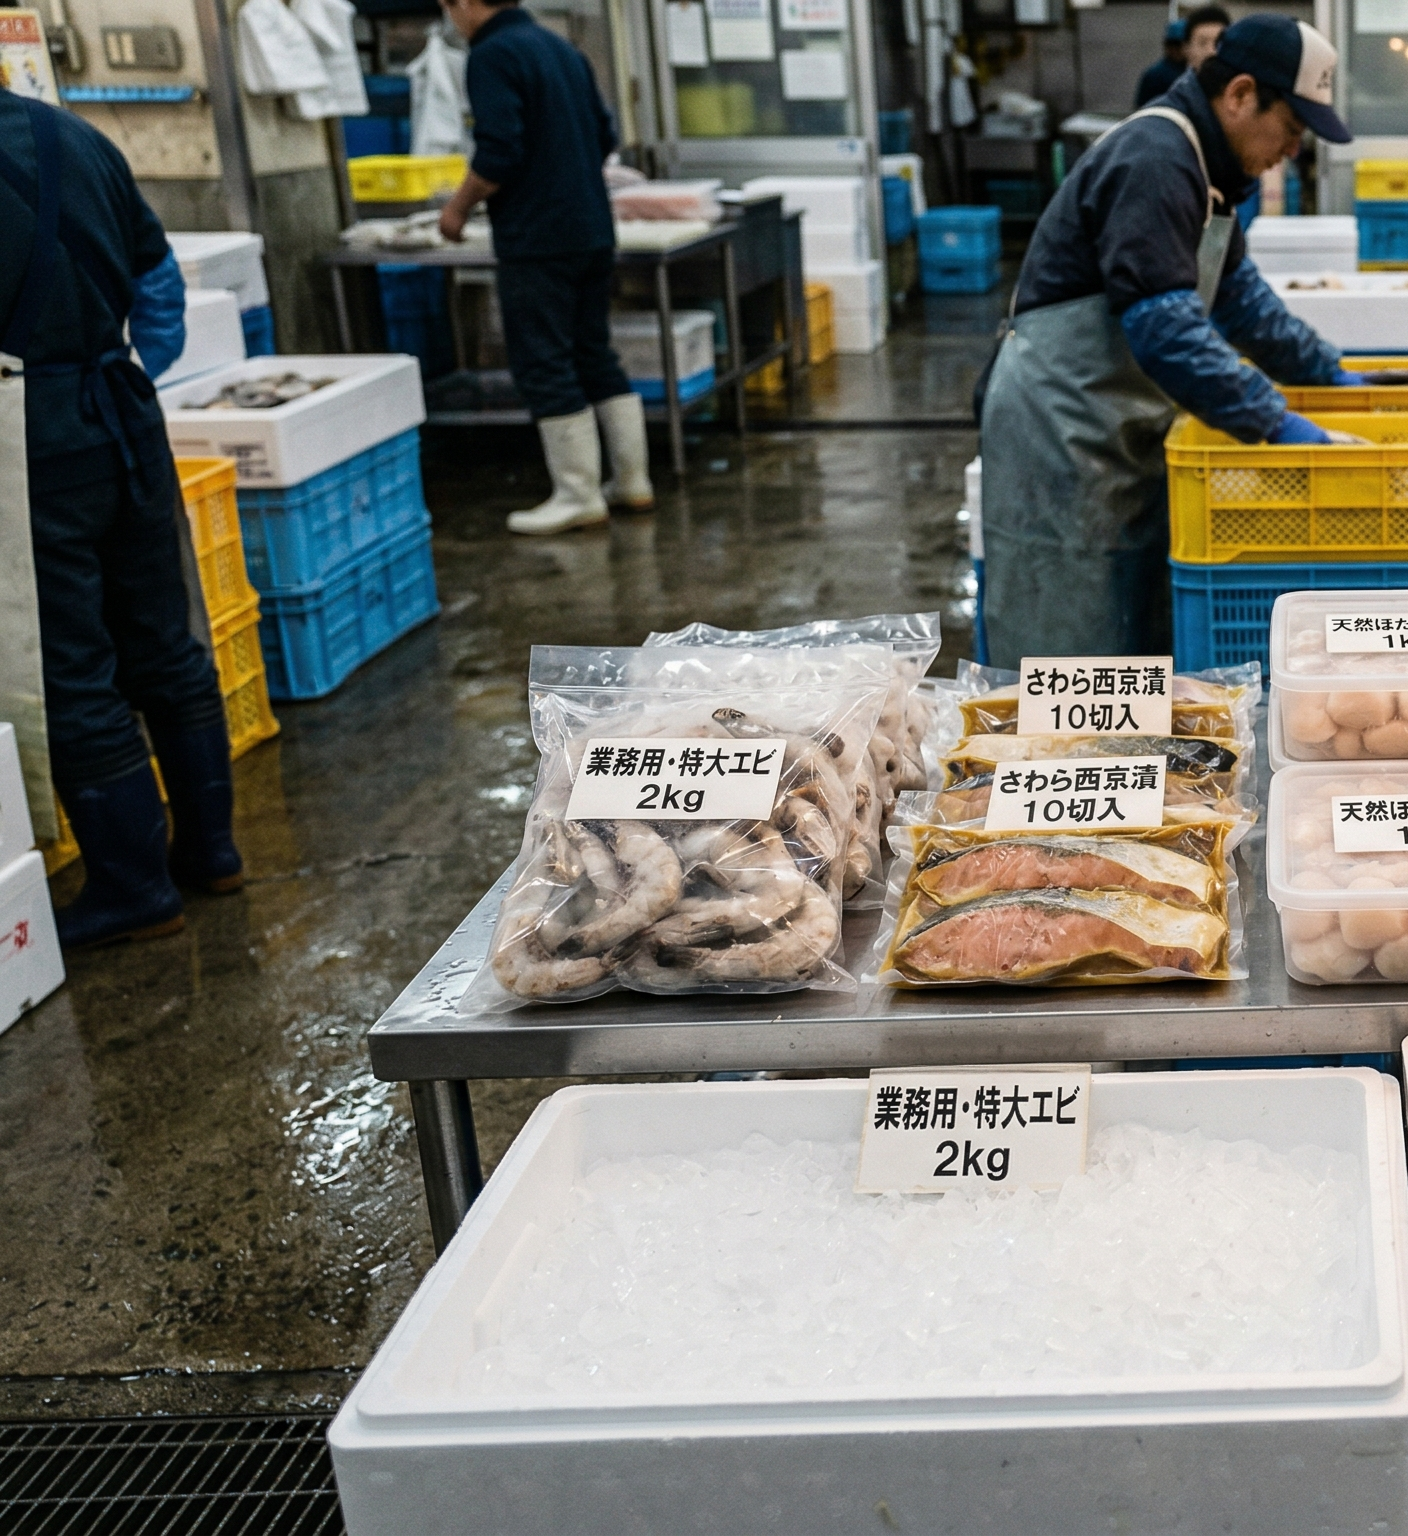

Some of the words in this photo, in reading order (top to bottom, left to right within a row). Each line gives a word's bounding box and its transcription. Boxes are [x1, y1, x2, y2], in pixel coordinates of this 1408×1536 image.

[1026, 666, 1166, 696] さわら西京漬
[1050, 703, 1139, 731] 10切入
[585, 746, 777, 777] 業務用・特大エビ
[999, 764, 1159, 794] さわら西京漬
[635, 783, 705, 813] 2kg
[1023, 797, 1126, 823] 10切入
[874, 1085, 1081, 1130] 業務用・特大エビ
[933, 1140, 1011, 1181] 2kg
